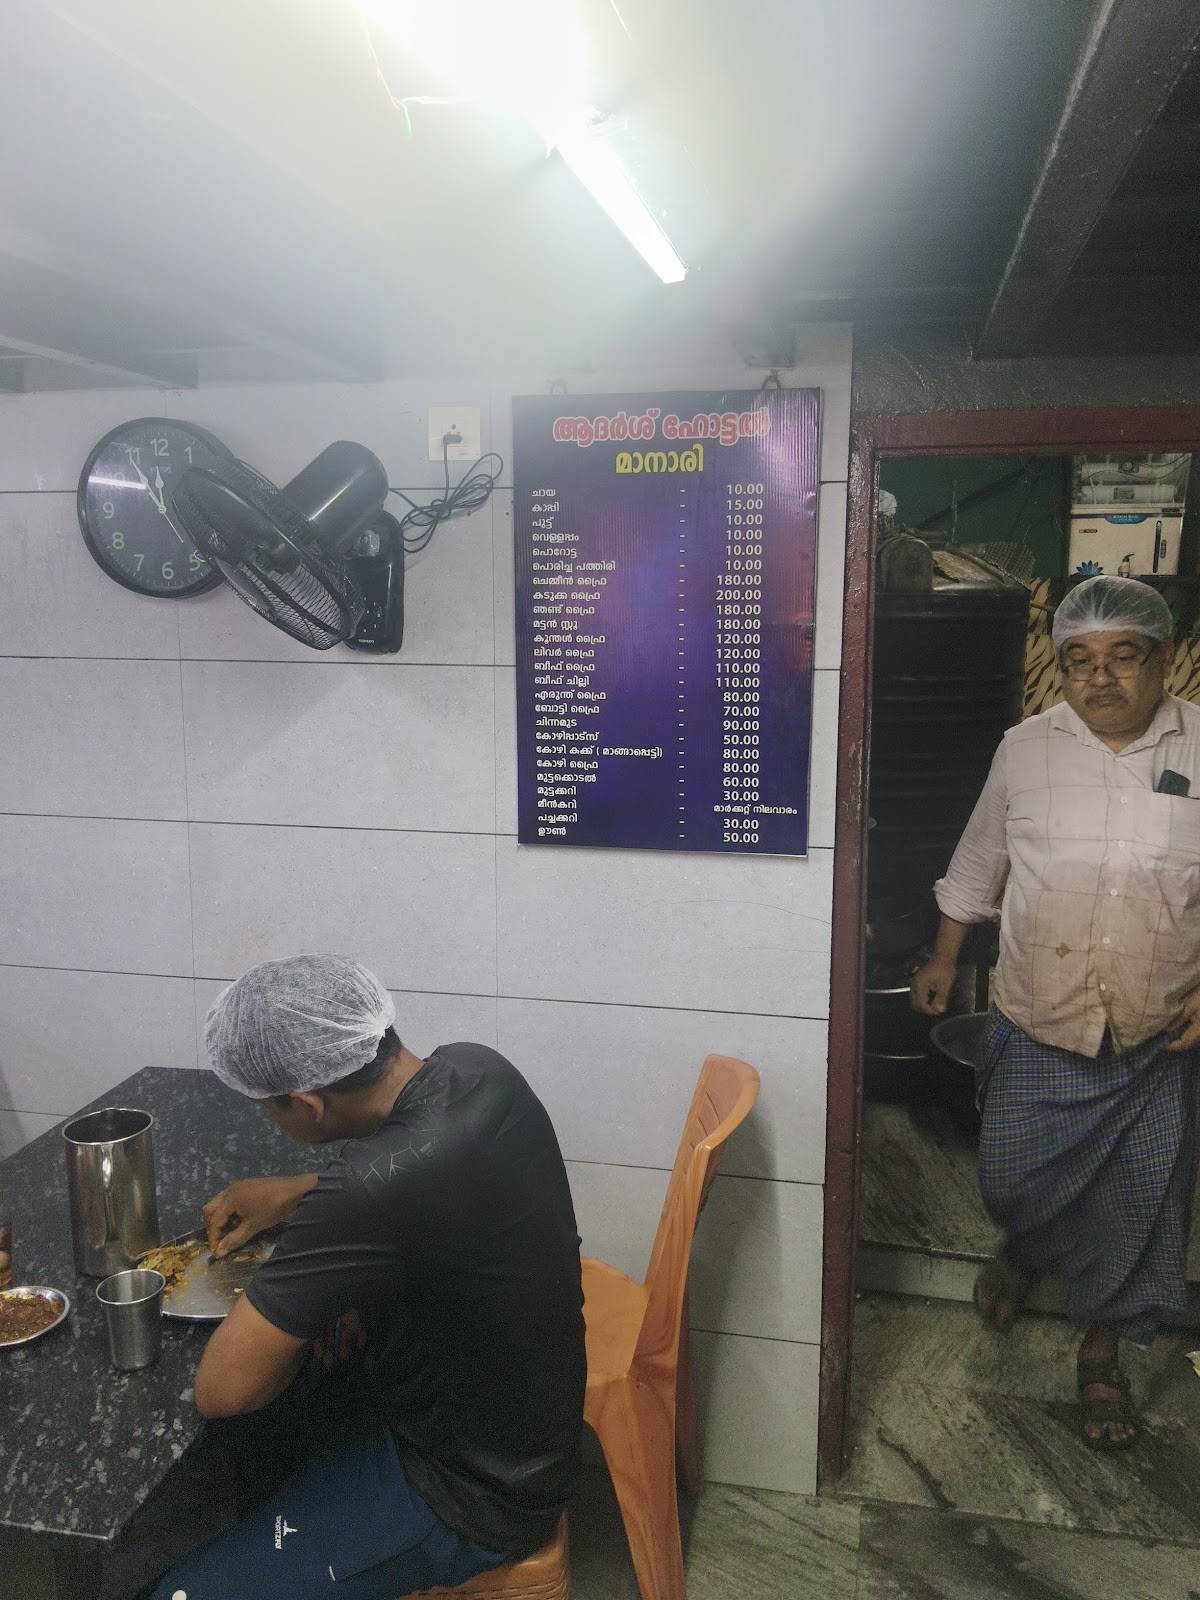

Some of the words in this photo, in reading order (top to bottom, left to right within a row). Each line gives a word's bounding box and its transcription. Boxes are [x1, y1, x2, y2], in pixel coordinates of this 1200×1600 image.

[552, 407, 661, 448] ആദർശ്
[662, 406, 771, 446] ഹോട്ടൽ
[150, 438, 170, 457] 12
[126, 448, 141, 465] 11
[184, 446, 193, 464] 1
[615, 443, 704, 474] മാനാരി
[531, 488, 556, 497] ചായ
[727, 483, 764, 495] 10.00
[102, 502, 115, 519] 9
[531, 501, 560, 513] കാപ്പി
[726, 498, 763, 511] 15.00
[531, 516, 555, 530] പുട്ട്
[726, 513, 763, 526] 10.00
[112, 532, 125, 549] 8
[532, 532, 580, 544] വെള്ളപ്പം
[726, 529, 763, 541] 10.00
[532, 547, 578, 559] പൊറോട്ട
[725, 544, 763, 556] 10.00
[133, 554, 145, 571] 7
[532, 560, 573, 573] പൊരിച്ച
[576, 560, 616, 572] പത്തിരി
[725, 559, 762, 571] 10.00
[162, 562, 174, 579] 6
[577, 577, 607, 588] ഫ്രൈ
[716, 574, 762, 586] 180.00
[532, 591, 568, 602] കടുക്ക
[570, 591, 601, 602] ഫ്രൈ
[715, 589, 762, 601] 200.00
[532, 603, 564, 615] ഞണ്ട്
[565, 606, 595, 617] ഫ്രൈ
[716, 604, 762, 616] 180.00
[532, 619, 558, 631] മട്ടൻ
[716, 618, 761, 630] 180.00
[575, 634, 606, 645] ഫ്രൈ
[716, 633, 761, 645] 120.00
[533, 645, 563, 657] ലിവർ
[565, 648, 595, 659] ഫ്രൈ
[715, 648, 761, 659] 120.00
[534, 660, 565, 671] ബീഫ്
[565, 662, 596, 673] ഫ്രൈ
[715, 662, 761, 674] 110.00
[534, 674, 565, 685] ബീഫ്
[715, 677, 761, 688] 110.00
[576, 691, 607, 702] ഫ്രൈ
[722, 691, 761, 703] 80.00
[534, 702, 568, 716] ബോട്ടി
[570, 705, 600, 716] ഫ്രൈ
[723, 705, 760, 717] 70.00
[722, 719, 760, 731] 90.00
[723, 734, 760, 746] 50.00
[535, 743, 567, 755] കോഴി
[722, 748, 760, 760] 80.00
[536, 757, 567, 769] കോഴി
[569, 760, 599, 771] ഫ്രൈ
[722, 762, 760, 774] 80.00
[722, 776, 760, 788] 60.00
[723, 790, 760, 802] 30.00
[753, 804, 798, 815] നിലവാരം
[723, 818, 760, 830] 30.00
[537, 826, 568, 838] ഊൺ
[722, 831, 759, 844] 50.00
